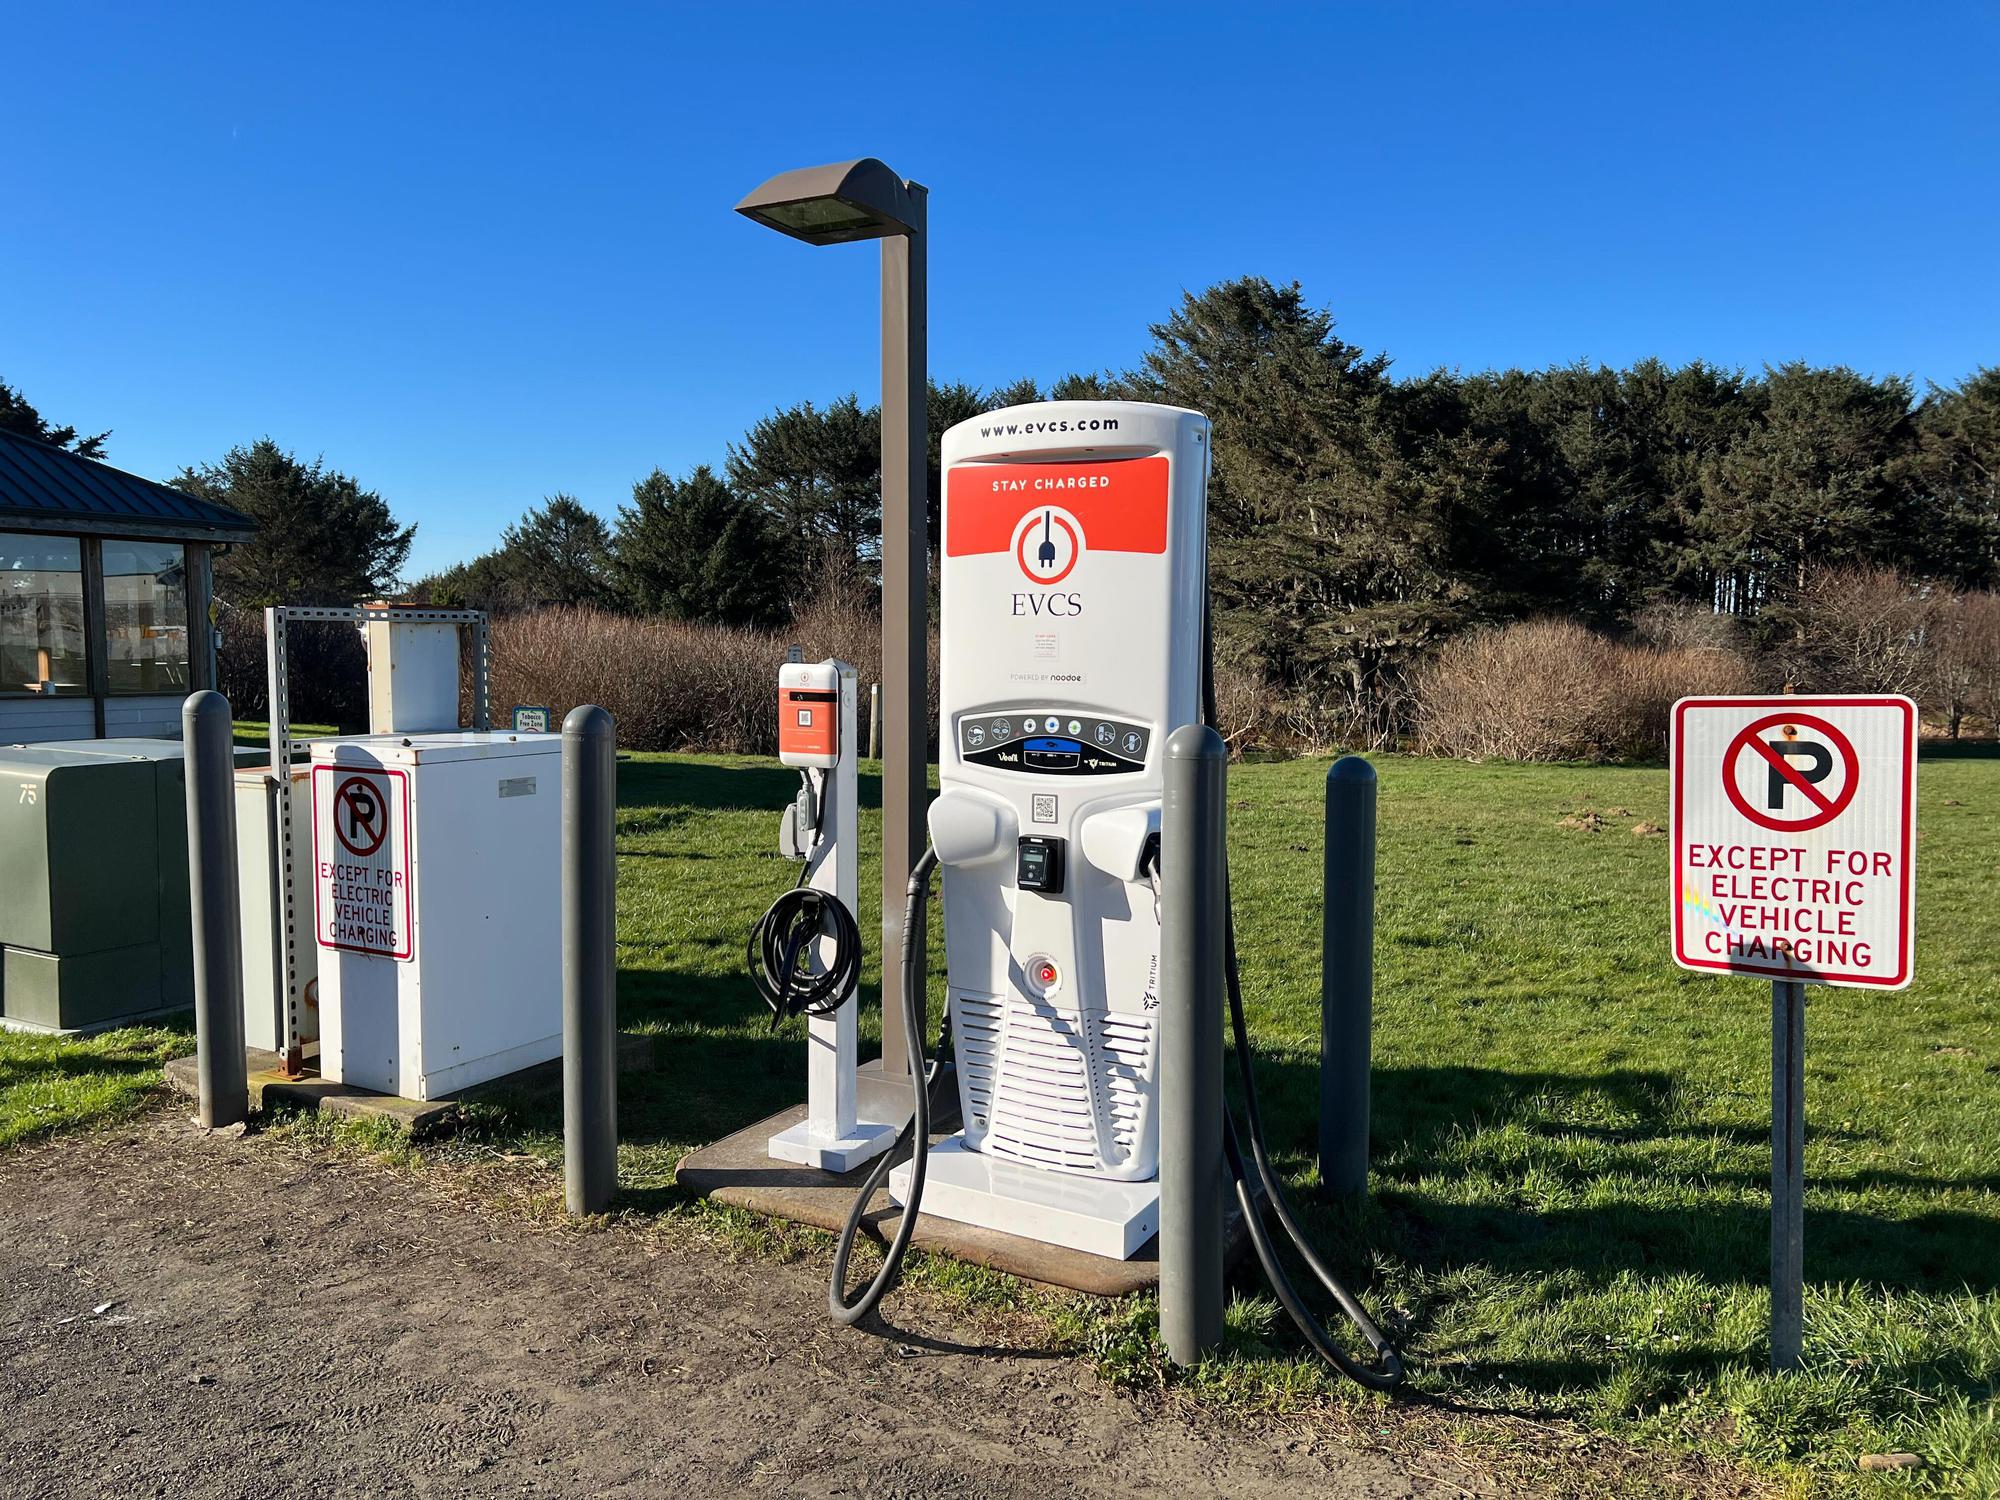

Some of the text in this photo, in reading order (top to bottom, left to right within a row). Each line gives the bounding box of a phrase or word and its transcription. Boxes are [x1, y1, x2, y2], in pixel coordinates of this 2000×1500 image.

[981, 418, 1119, 438] www.evcs.com
[992, 476, 1109, 491] STAY CHARGED
[1011, 593, 1082, 616] EVCS
[1050, 674, 1082, 682] noodoe
[19, 783, 37, 805] 75
[1689, 844, 1892, 877] EXCEPT FOR
[321, 863, 403, 888] EXCEPT FOR
[332, 883, 393, 906] ELECTRIC
[1712, 874, 1864, 906] ELECTRIC
[335, 904, 391, 926] VEHICLE
[1719, 903, 1856, 936] VEHICLE
[329, 922, 397, 947] CHARGING
[1705, 931, 1872, 968] CHARGING
[1149, 954, 1158, 989] TRITIUM
